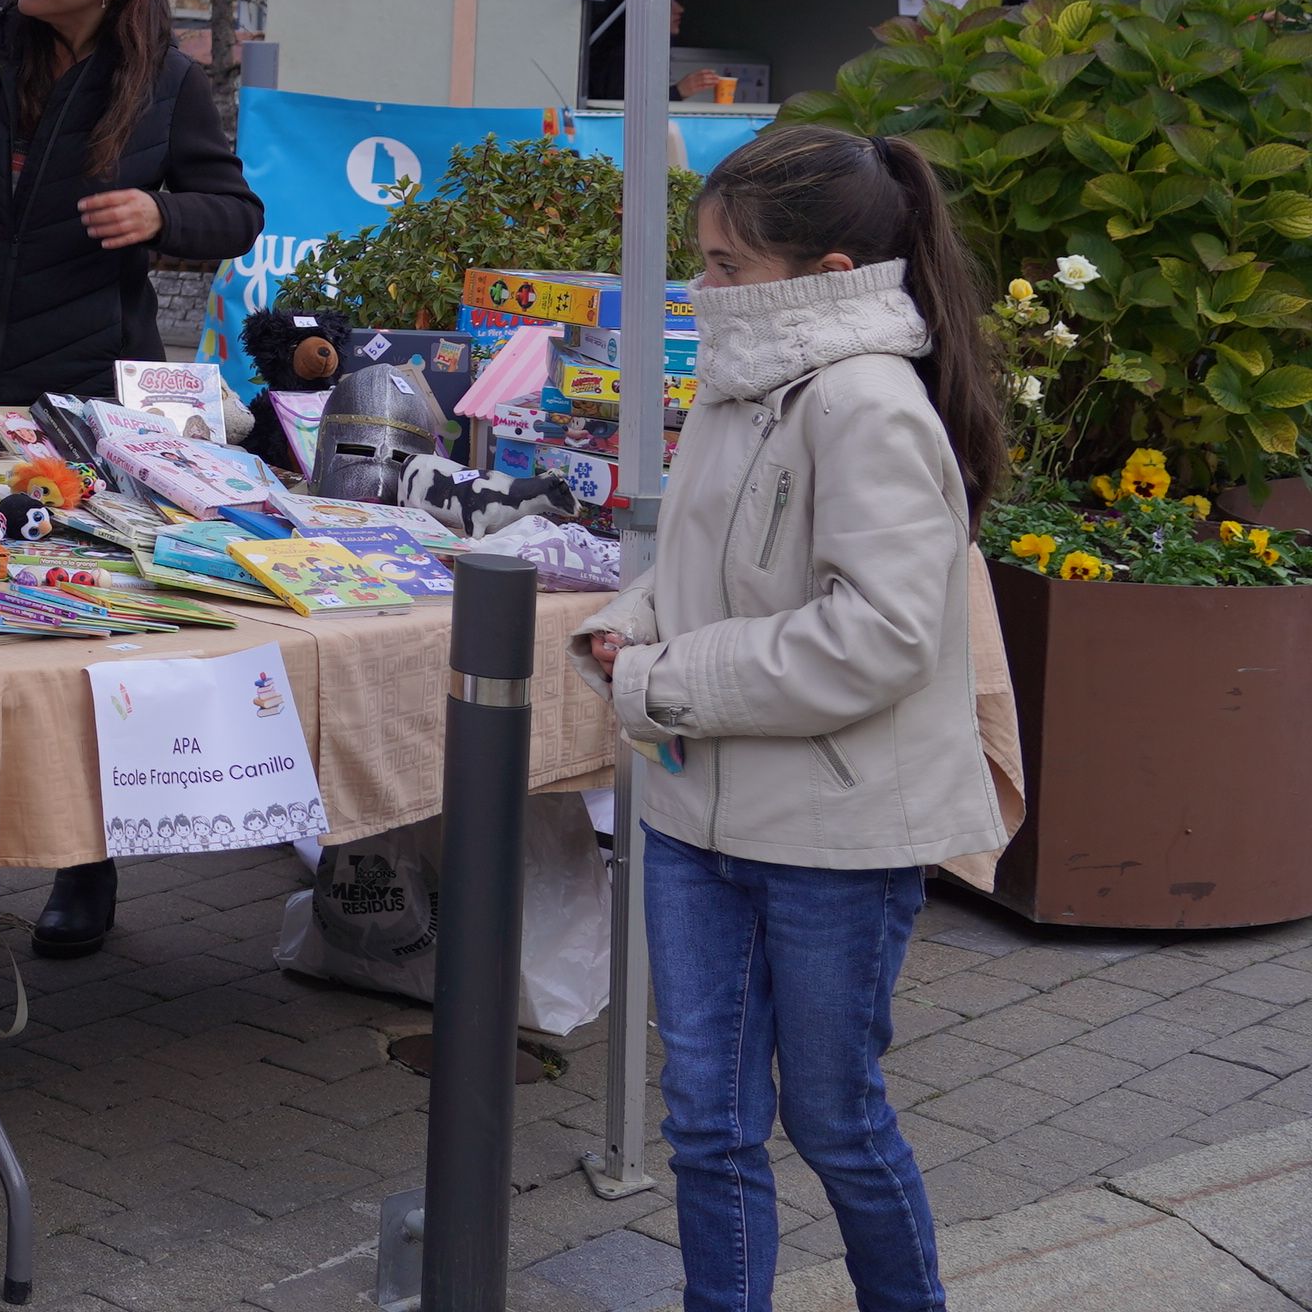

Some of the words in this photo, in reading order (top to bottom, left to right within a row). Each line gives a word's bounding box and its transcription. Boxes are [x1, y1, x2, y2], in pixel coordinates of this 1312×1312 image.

[106, 451, 134, 475] MARTINA
[172, 737, 202, 754] APA
[113, 766, 147, 787] École
[150, 768, 224, 789] Française
[229, 755, 295, 781] Canillo
[342, 897, 406, 916] RESIDUS
